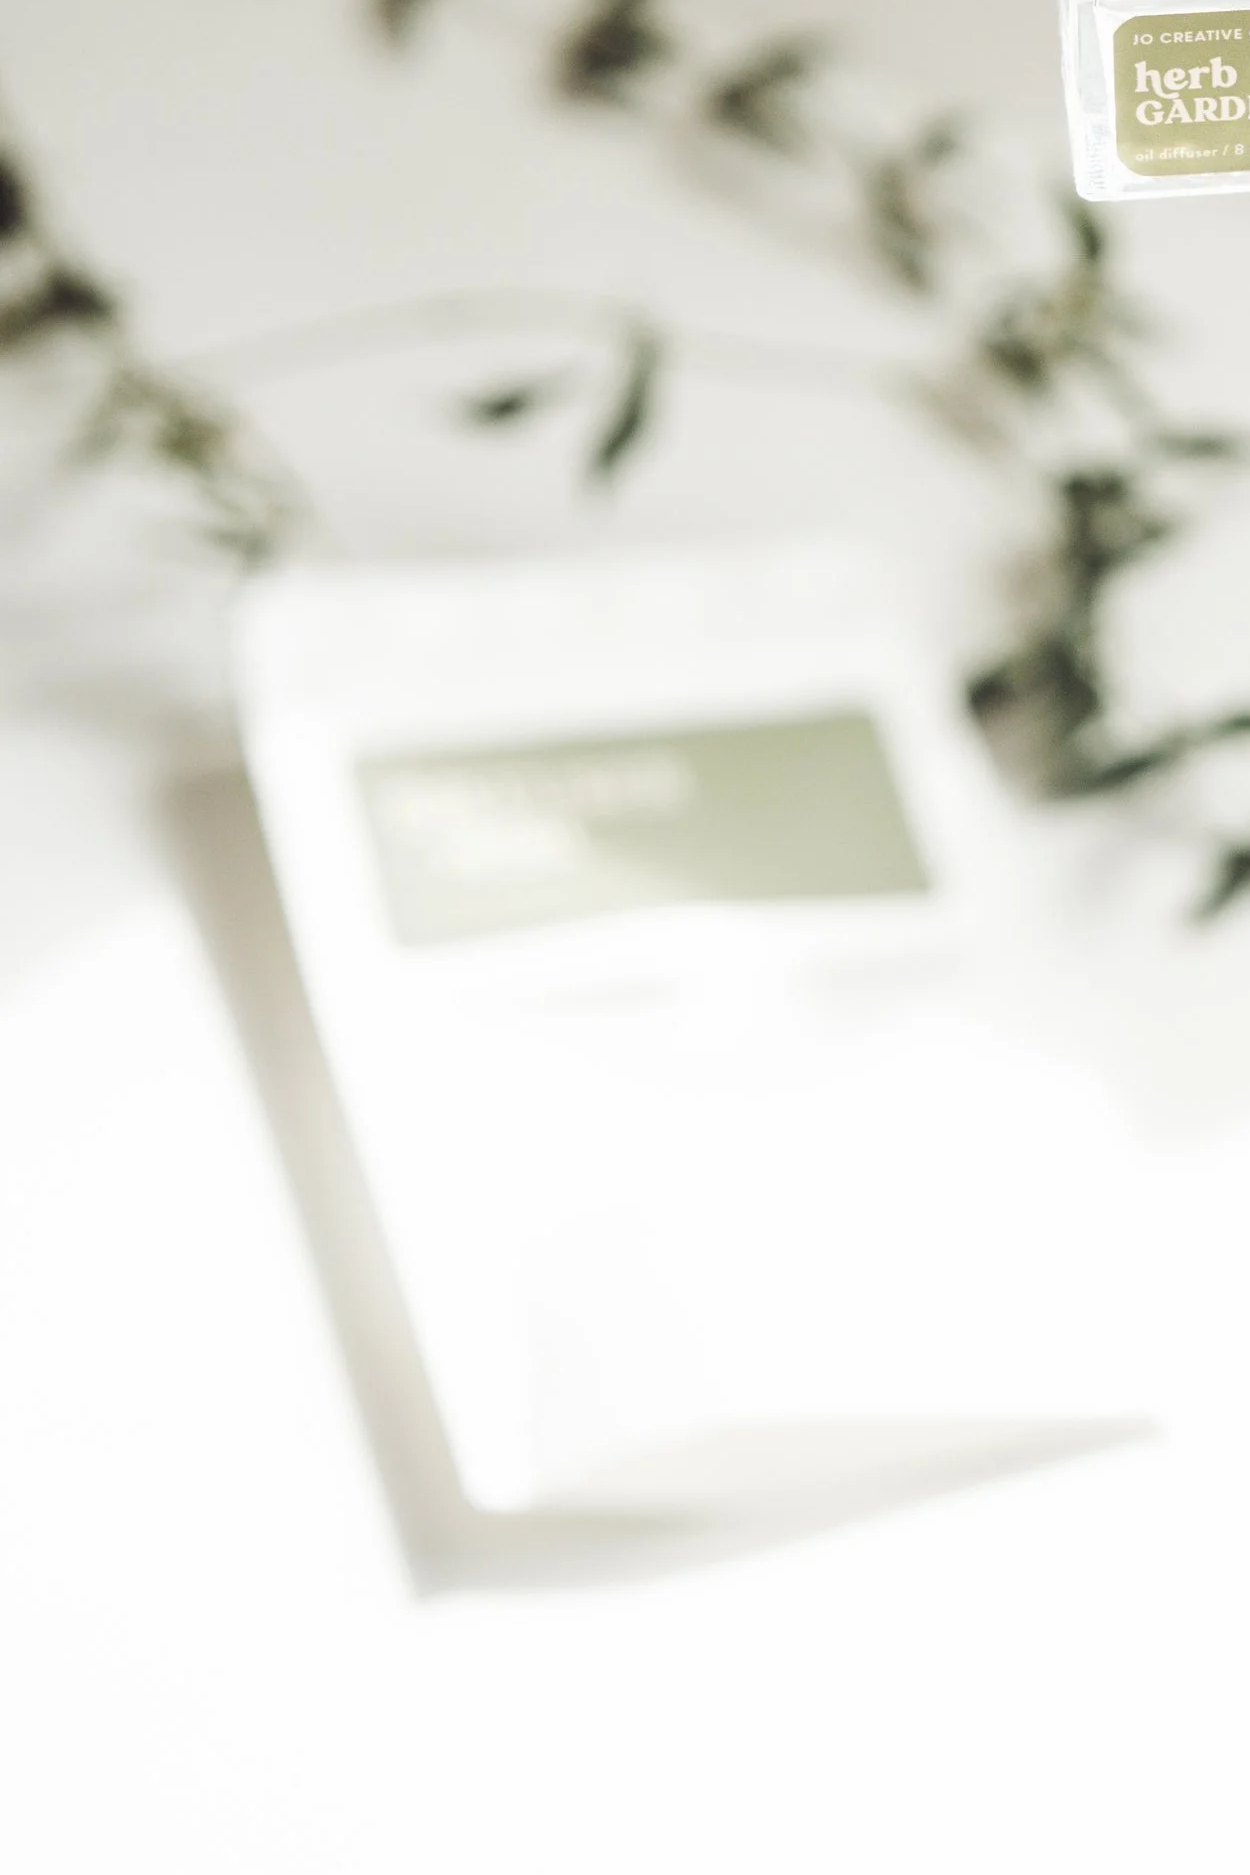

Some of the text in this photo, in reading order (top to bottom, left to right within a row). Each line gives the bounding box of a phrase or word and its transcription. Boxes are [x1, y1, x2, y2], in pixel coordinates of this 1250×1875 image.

[1132, 33, 1153, 45] JO
[1159, 28, 1243, 44] CREATIVE
[1134, 57, 1238, 99] herb
[1135, 149, 1154, 162] oil
[1159, 146, 1218, 160] diffuser
[1222, 144, 1230, 156] /
[1234, 143, 1244, 156] 8
